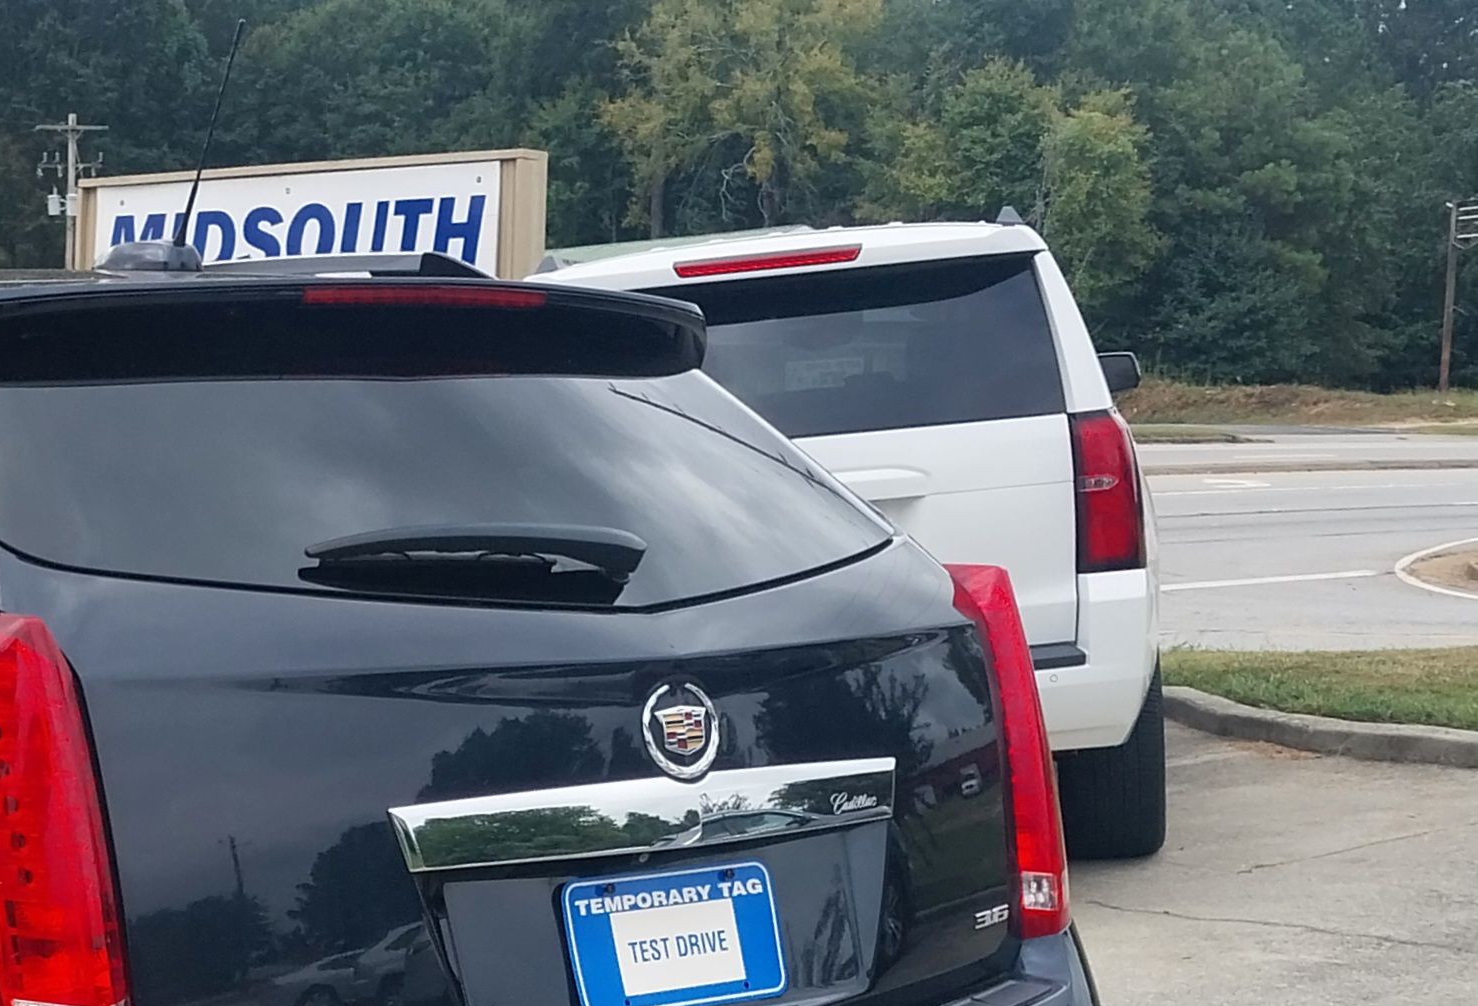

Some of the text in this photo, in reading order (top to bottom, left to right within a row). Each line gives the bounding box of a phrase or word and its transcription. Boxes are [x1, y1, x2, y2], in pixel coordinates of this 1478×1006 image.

[110, 195, 487, 265] DSOUTH
[574, 878, 764, 917] TEMPORARY TAG
[627, 929, 729, 964] TEST DRIVE
